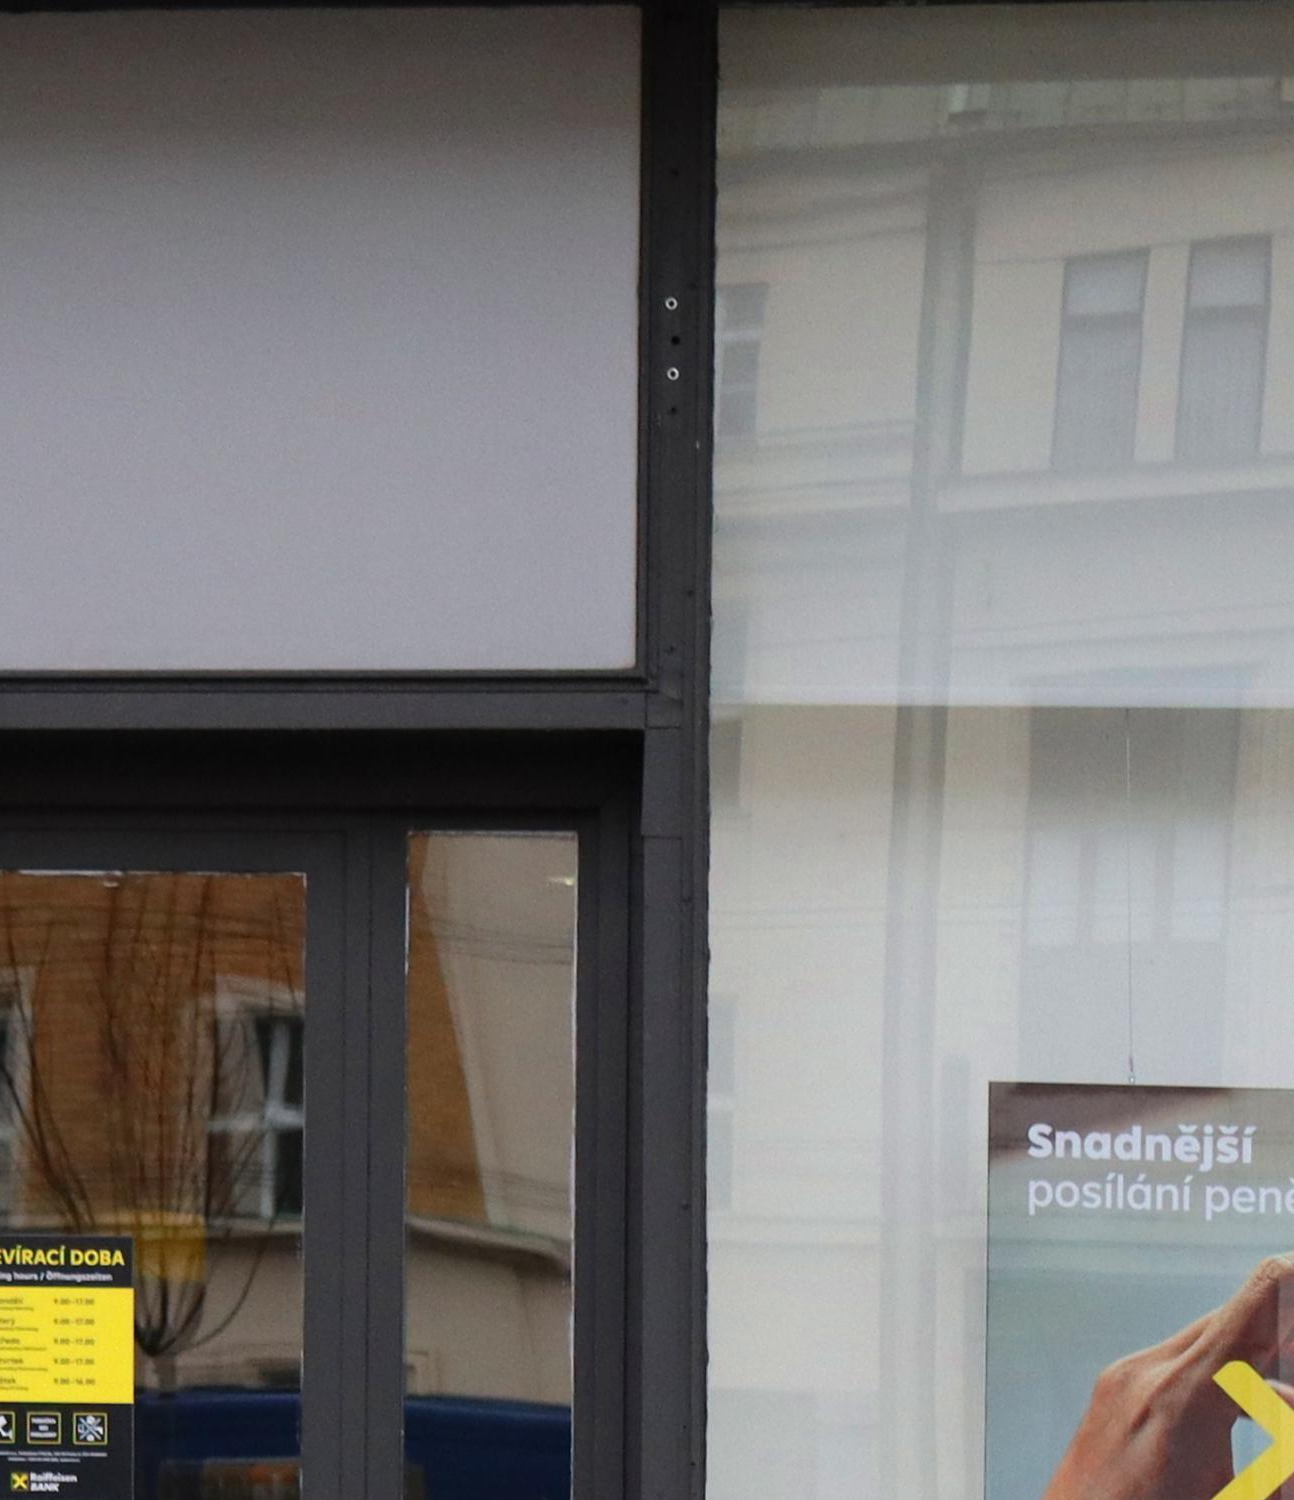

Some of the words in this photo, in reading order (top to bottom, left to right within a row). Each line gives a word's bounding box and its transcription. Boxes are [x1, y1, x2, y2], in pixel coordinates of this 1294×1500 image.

[1027, 1123, 1256, 1172] Snadnější
[1028, 1172, 1193, 1216] posílání
[70, 1249, 125, 1266] DOBA
